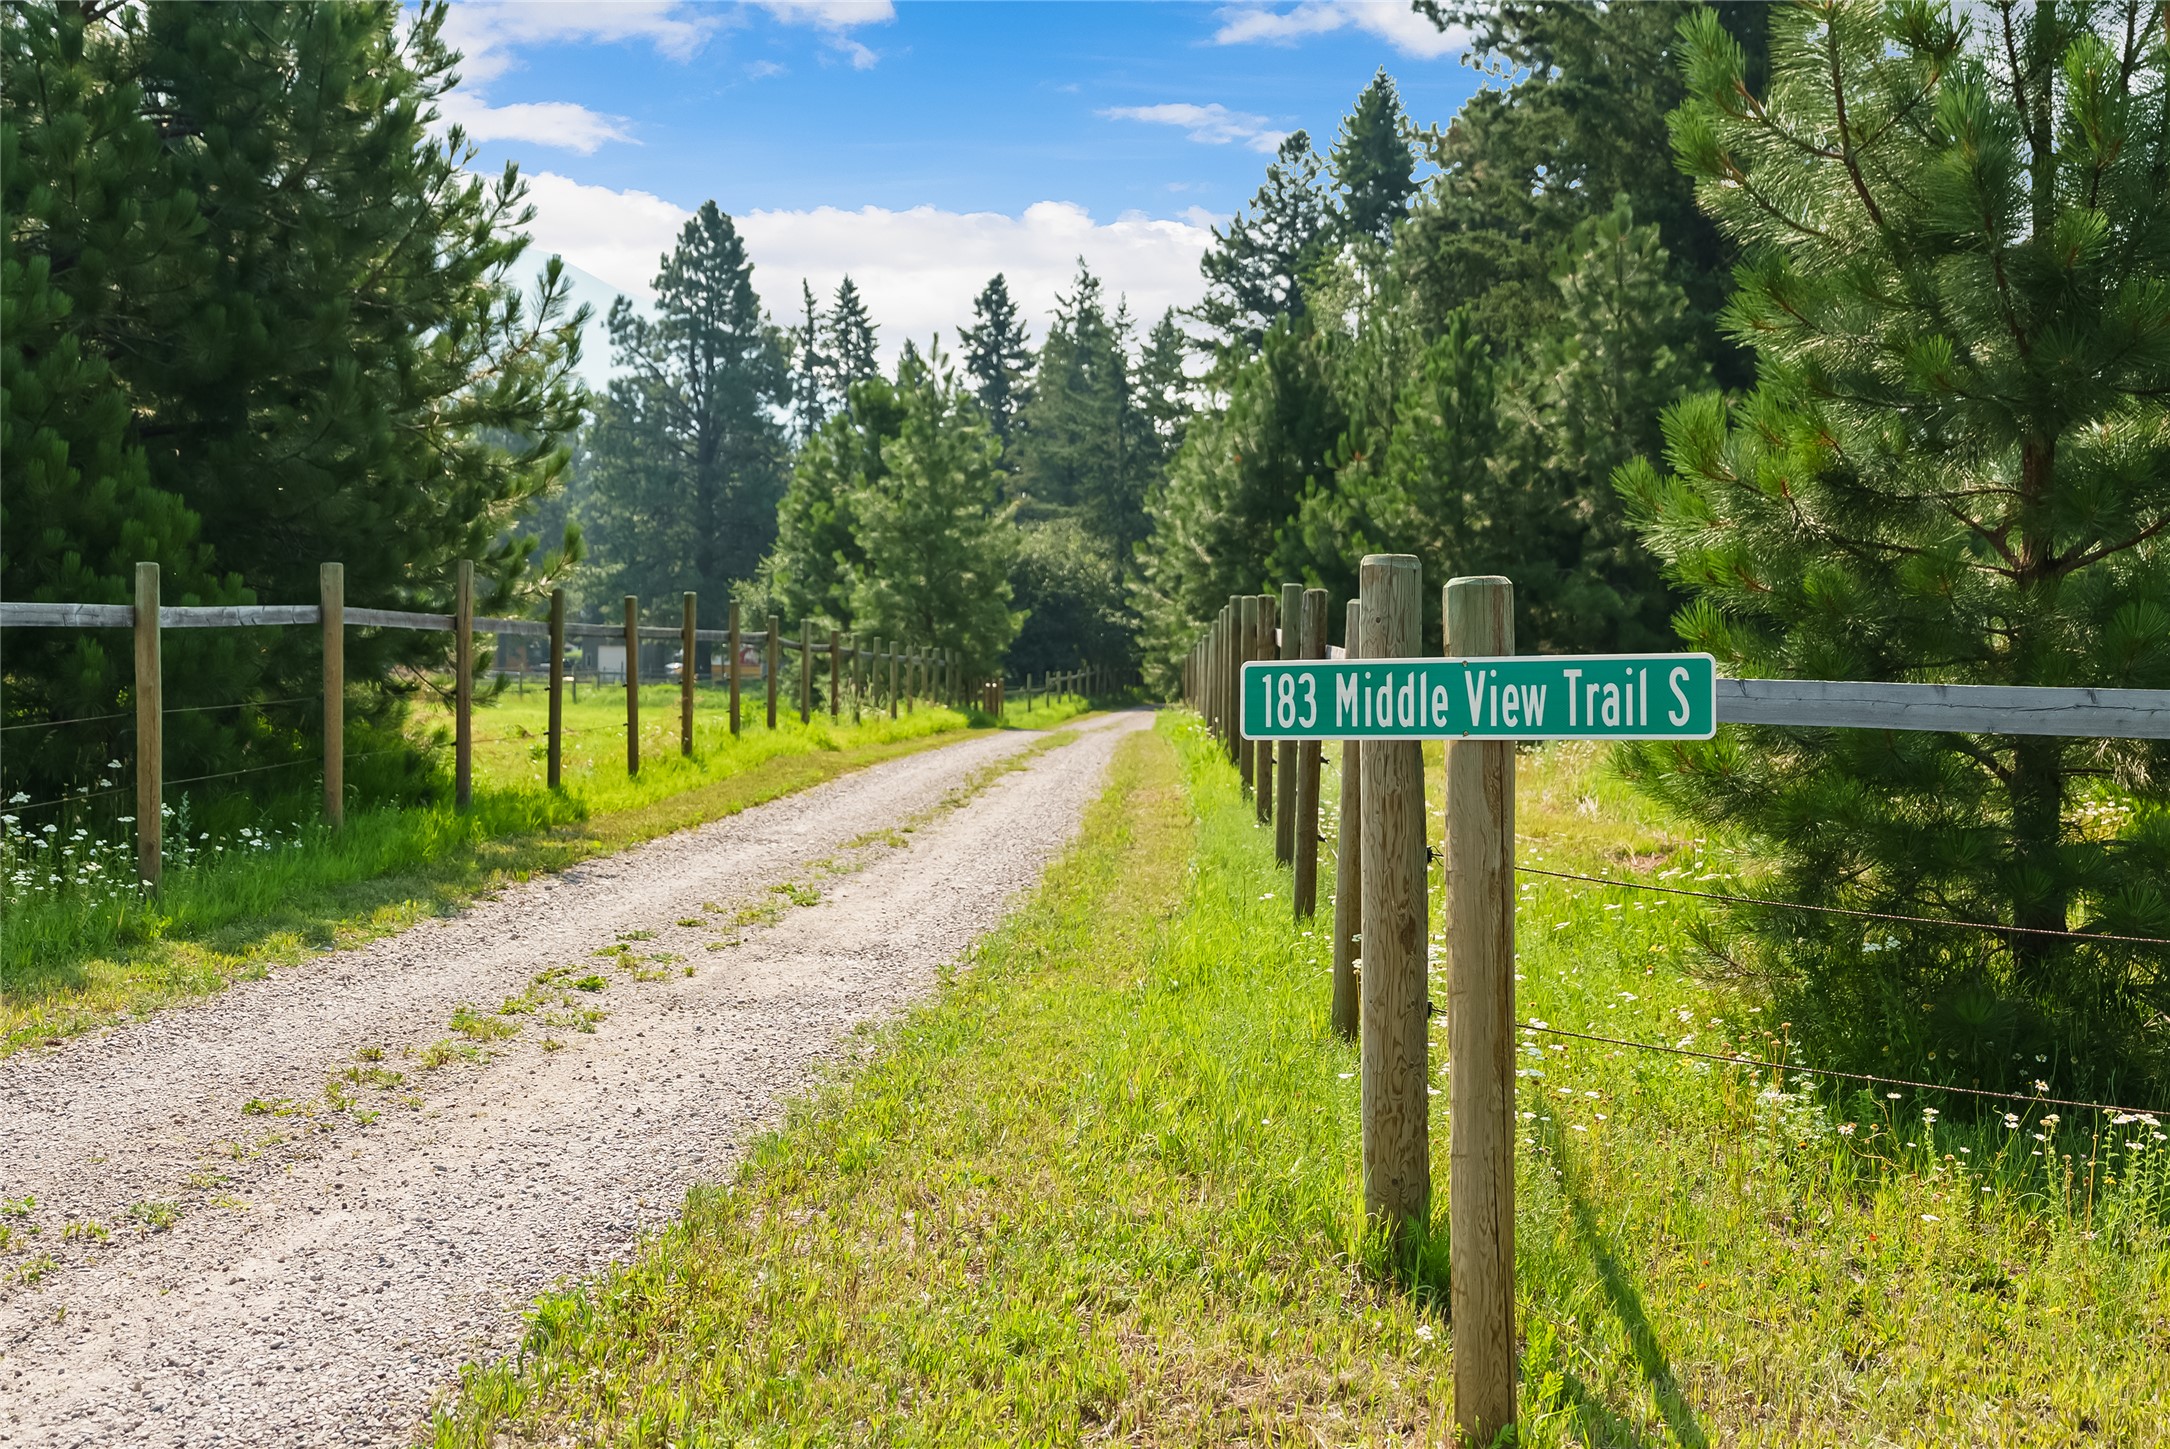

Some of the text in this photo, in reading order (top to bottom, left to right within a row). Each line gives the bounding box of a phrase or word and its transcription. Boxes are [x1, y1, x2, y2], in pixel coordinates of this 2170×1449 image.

[1262, 666, 1690, 728] 183 Middle View Trail S
